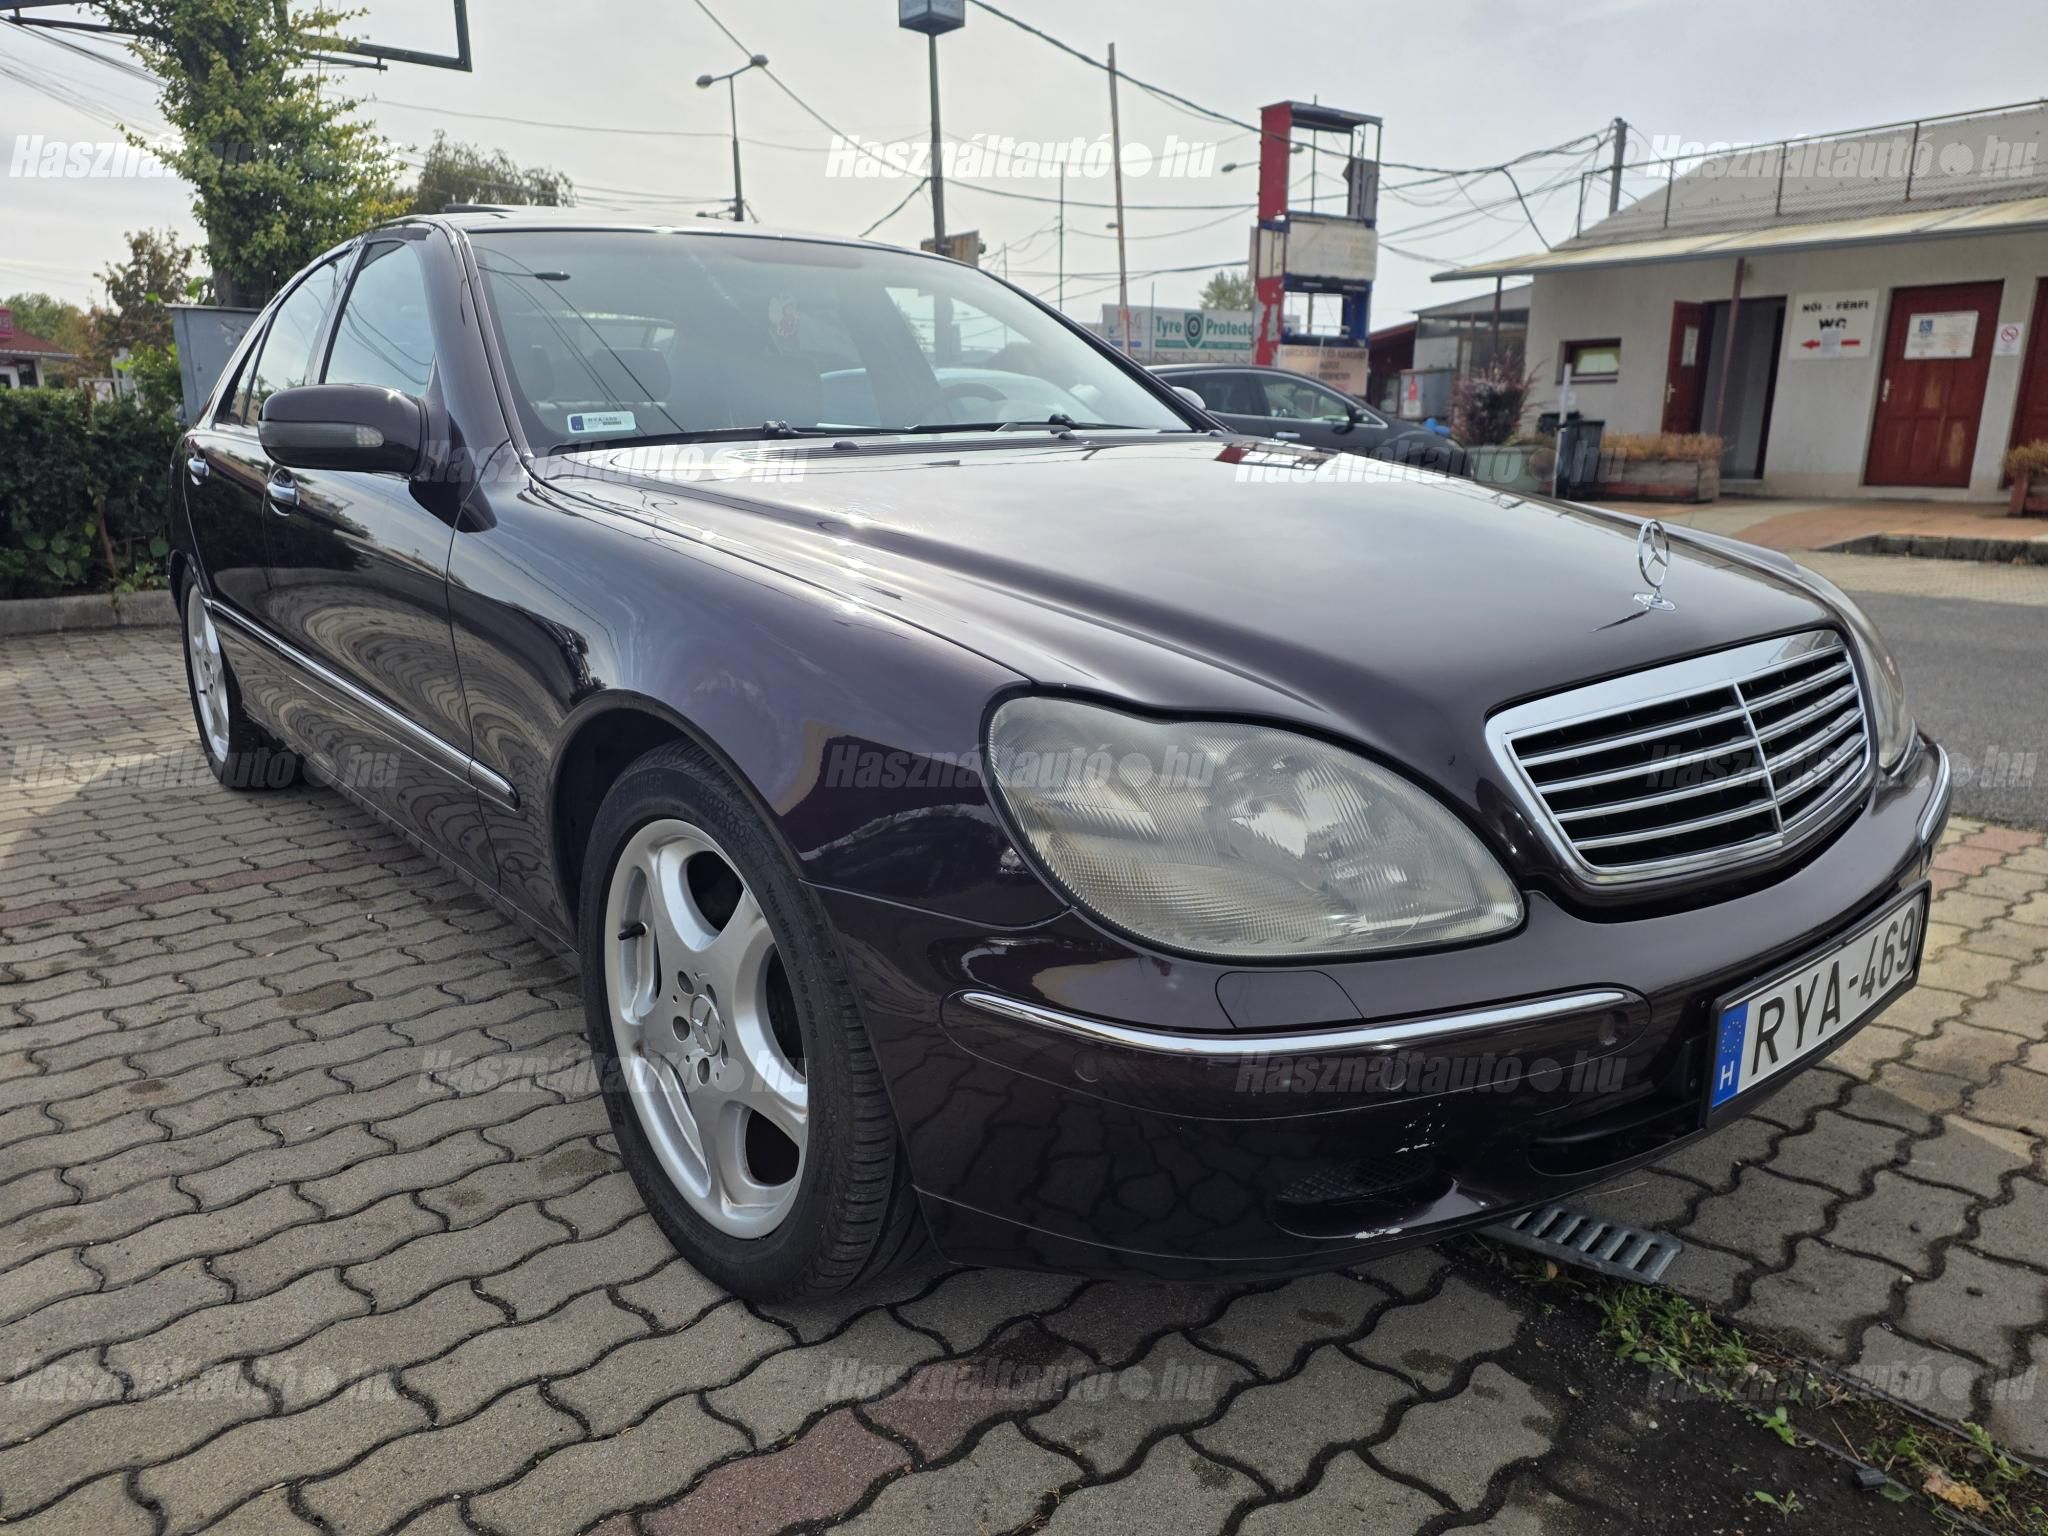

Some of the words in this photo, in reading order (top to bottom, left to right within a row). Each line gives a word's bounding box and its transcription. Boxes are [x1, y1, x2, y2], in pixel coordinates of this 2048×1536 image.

[1156, 316, 1182, 337] Tyre
[1819, 317, 1847, 331] WC
[1751, 907, 1916, 1076] RYA-469
[1719, 1060, 1734, 1090] H
